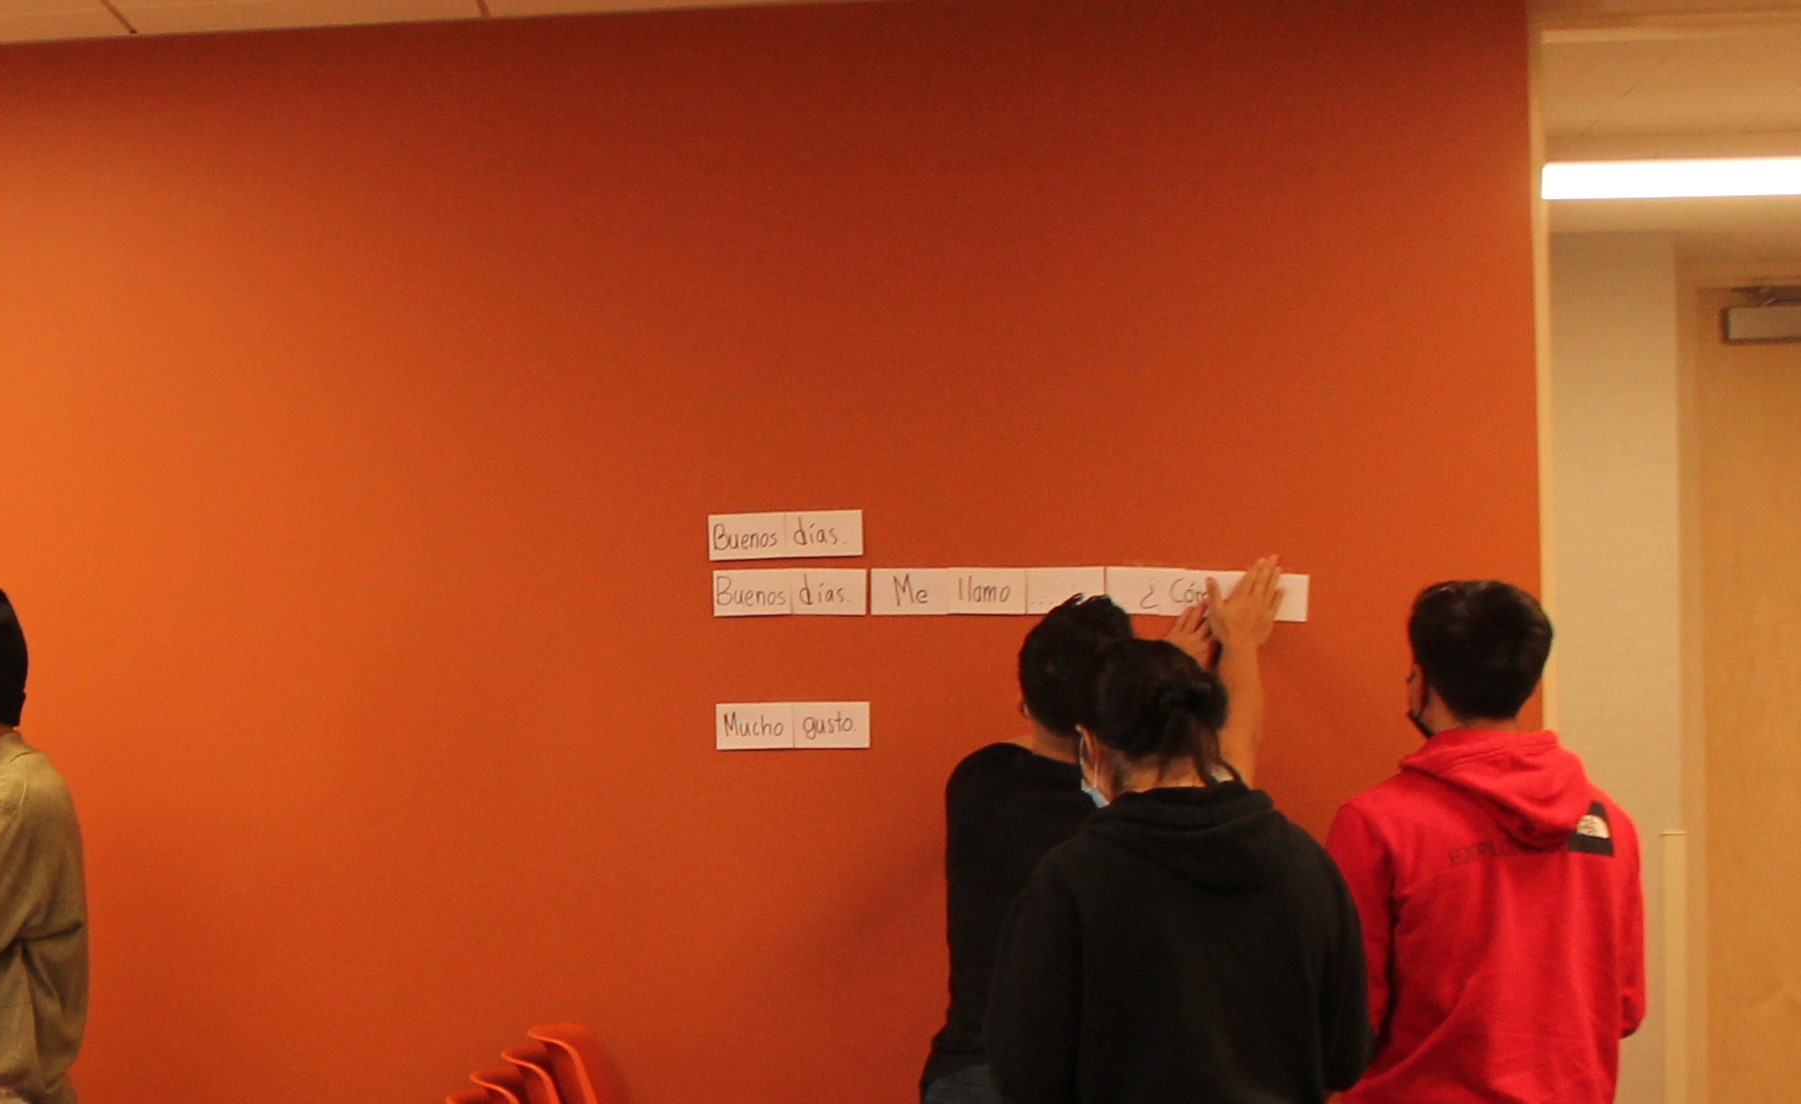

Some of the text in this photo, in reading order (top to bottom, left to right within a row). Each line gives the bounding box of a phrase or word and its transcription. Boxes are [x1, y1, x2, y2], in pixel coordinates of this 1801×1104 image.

[713, 516, 847, 551] Buenos días.
[716, 575, 786, 606] Buenos
[893, 574, 928, 605] Me
[958, 577, 1010, 603] llamo
[724, 711, 784, 737] Mucho
